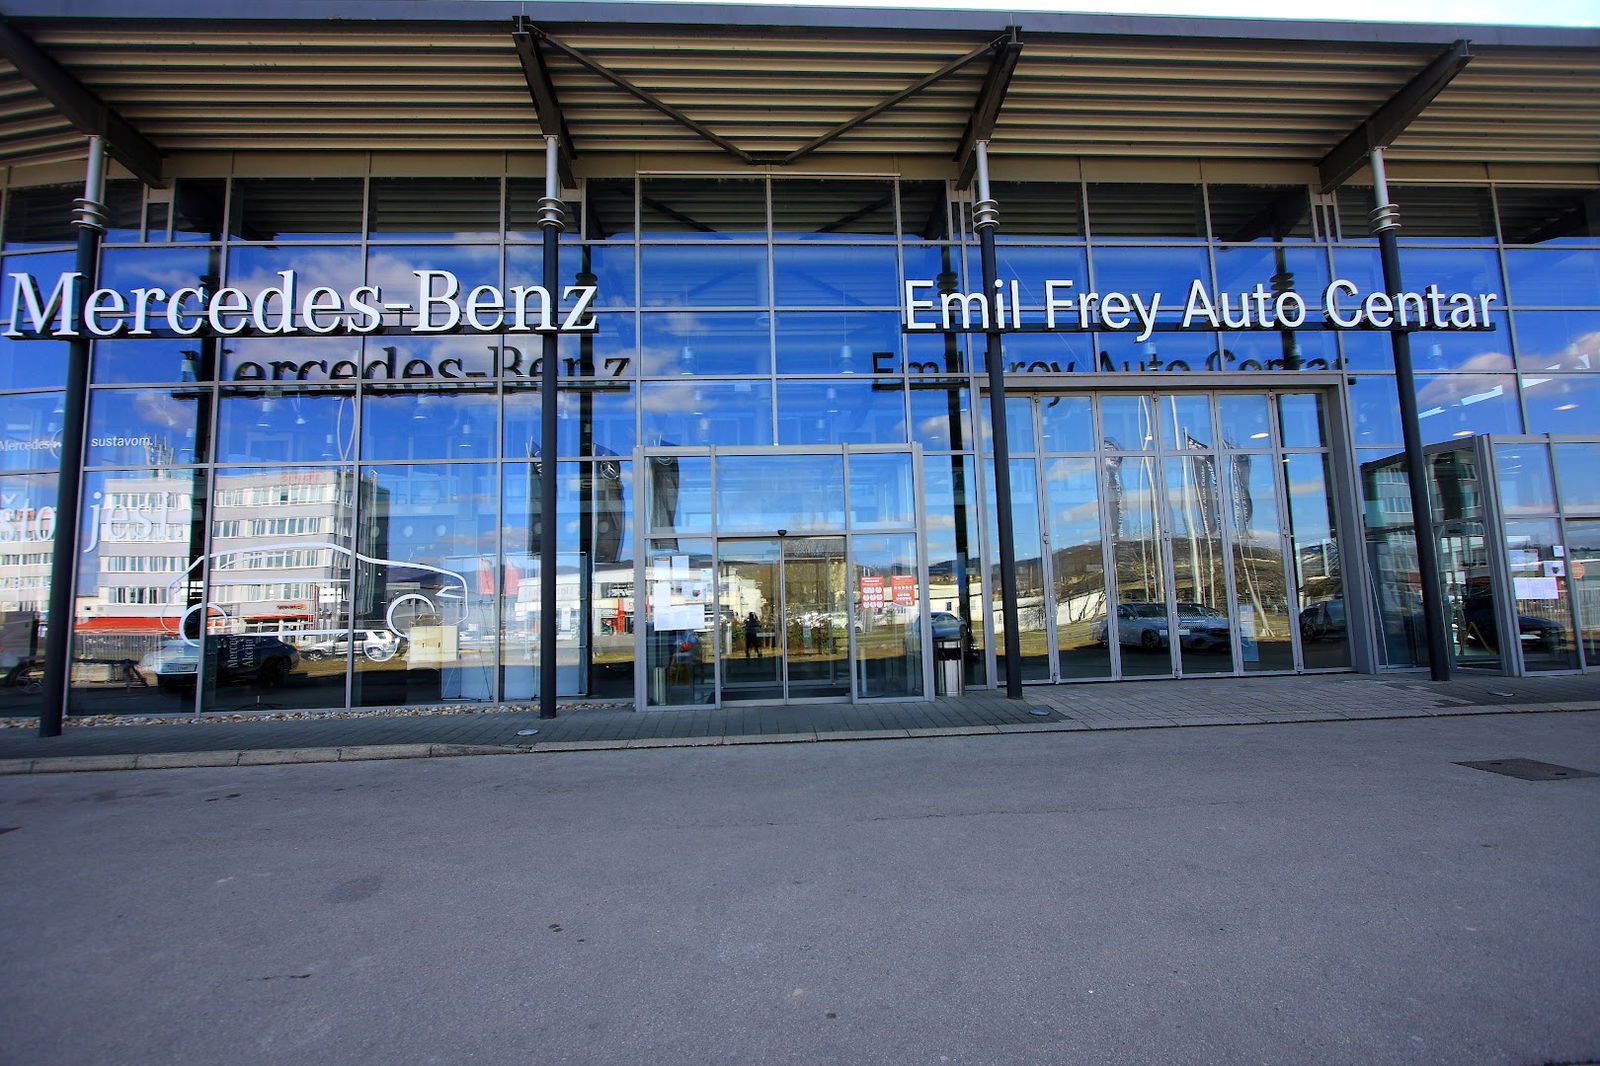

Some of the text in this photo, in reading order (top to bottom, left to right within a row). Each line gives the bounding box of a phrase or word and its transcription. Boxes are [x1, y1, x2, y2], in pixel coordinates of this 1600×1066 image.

[3, 269, 598, 337] Mercedes-Benz
[905, 279, 1497, 342] Emil Frey Auto Centar
[91, 435, 154, 448] sustavom.
